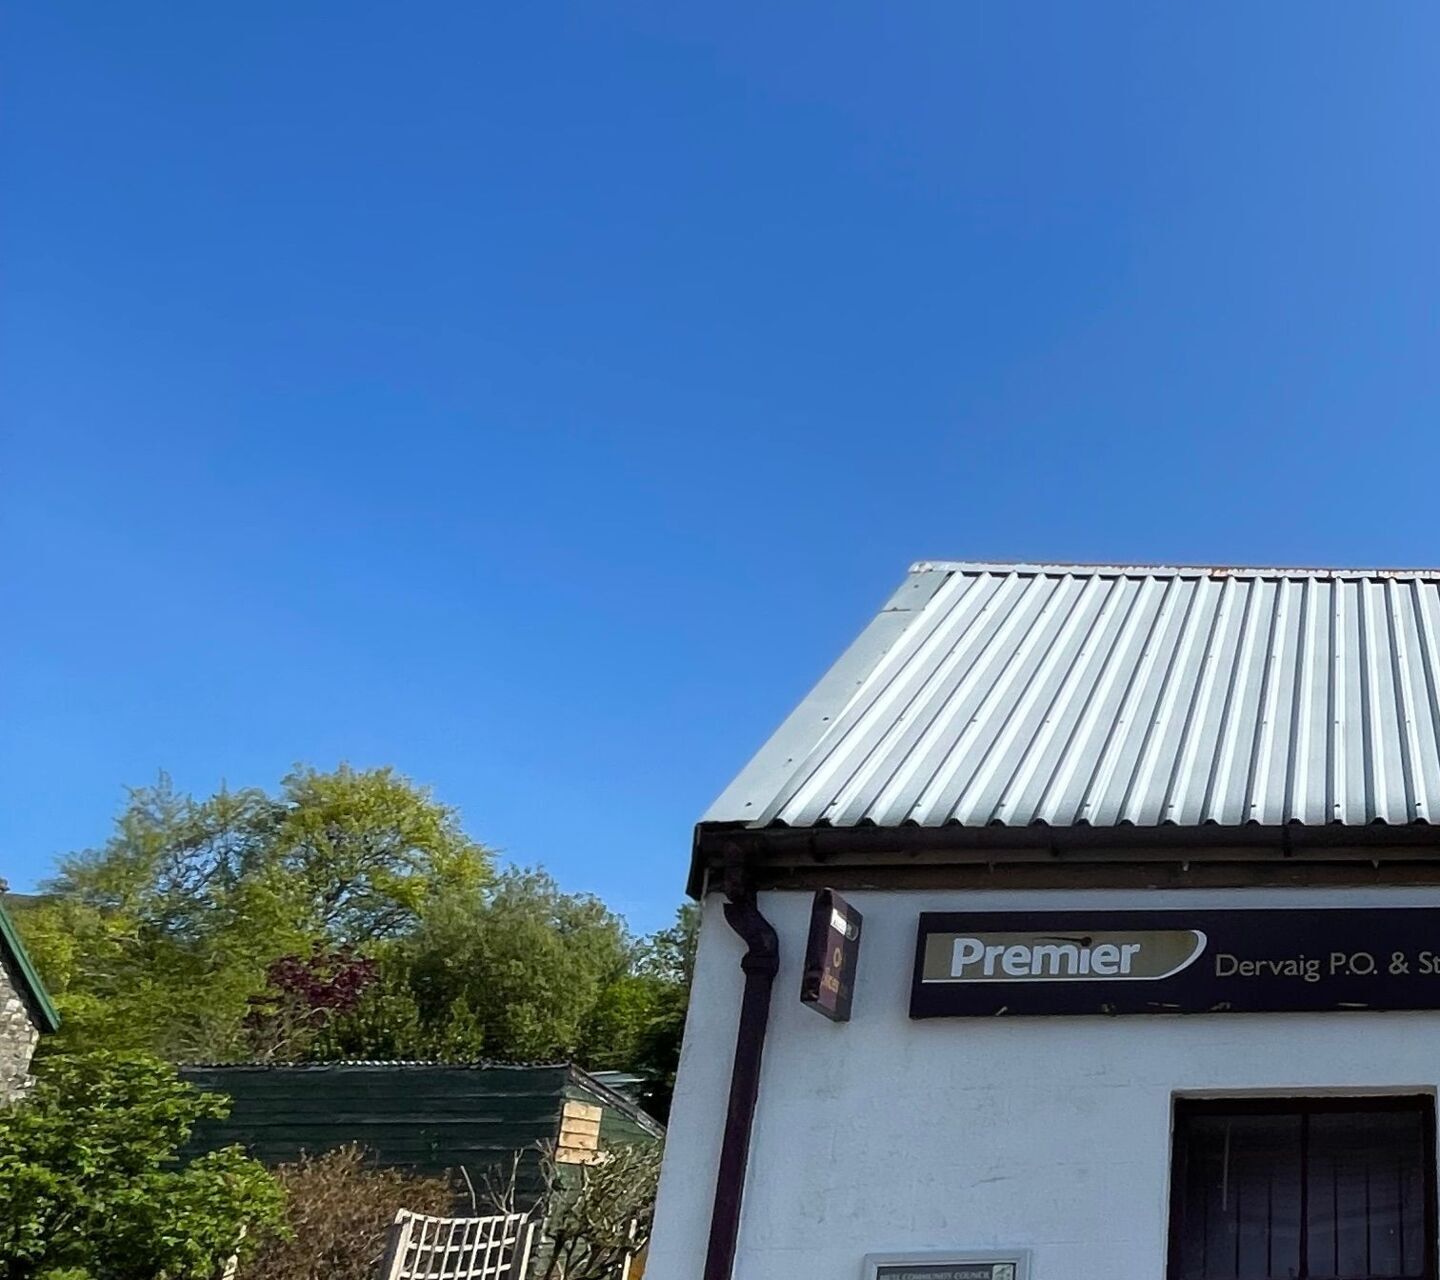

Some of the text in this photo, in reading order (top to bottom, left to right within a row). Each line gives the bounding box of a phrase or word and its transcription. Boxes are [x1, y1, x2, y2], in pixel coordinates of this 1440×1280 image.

[950, 937, 1141, 977] Premier
[1215, 953, 1321, 982] Dervaig
[1329, 952, 1378, 975] P.O.
[1388, 951, 1409, 975] &
